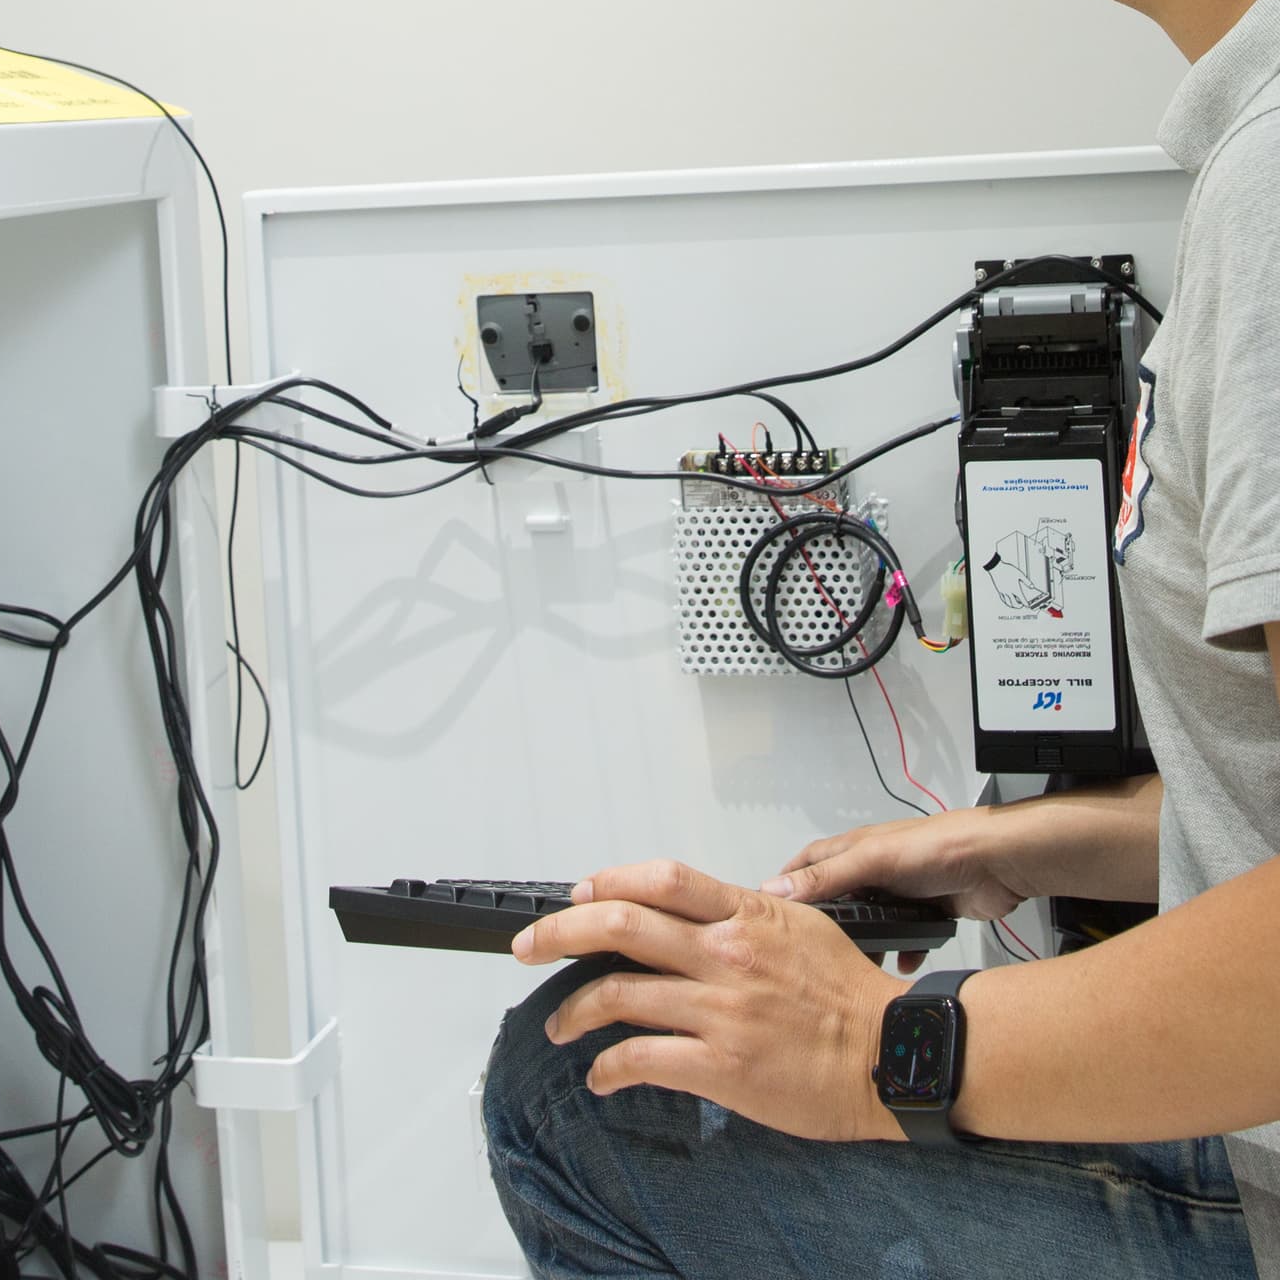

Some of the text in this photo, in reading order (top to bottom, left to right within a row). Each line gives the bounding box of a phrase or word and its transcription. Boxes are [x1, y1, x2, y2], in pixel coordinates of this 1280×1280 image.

[1004, 478, 1067, 486] Technologies
[982, 484, 1089, 493] International Currency
